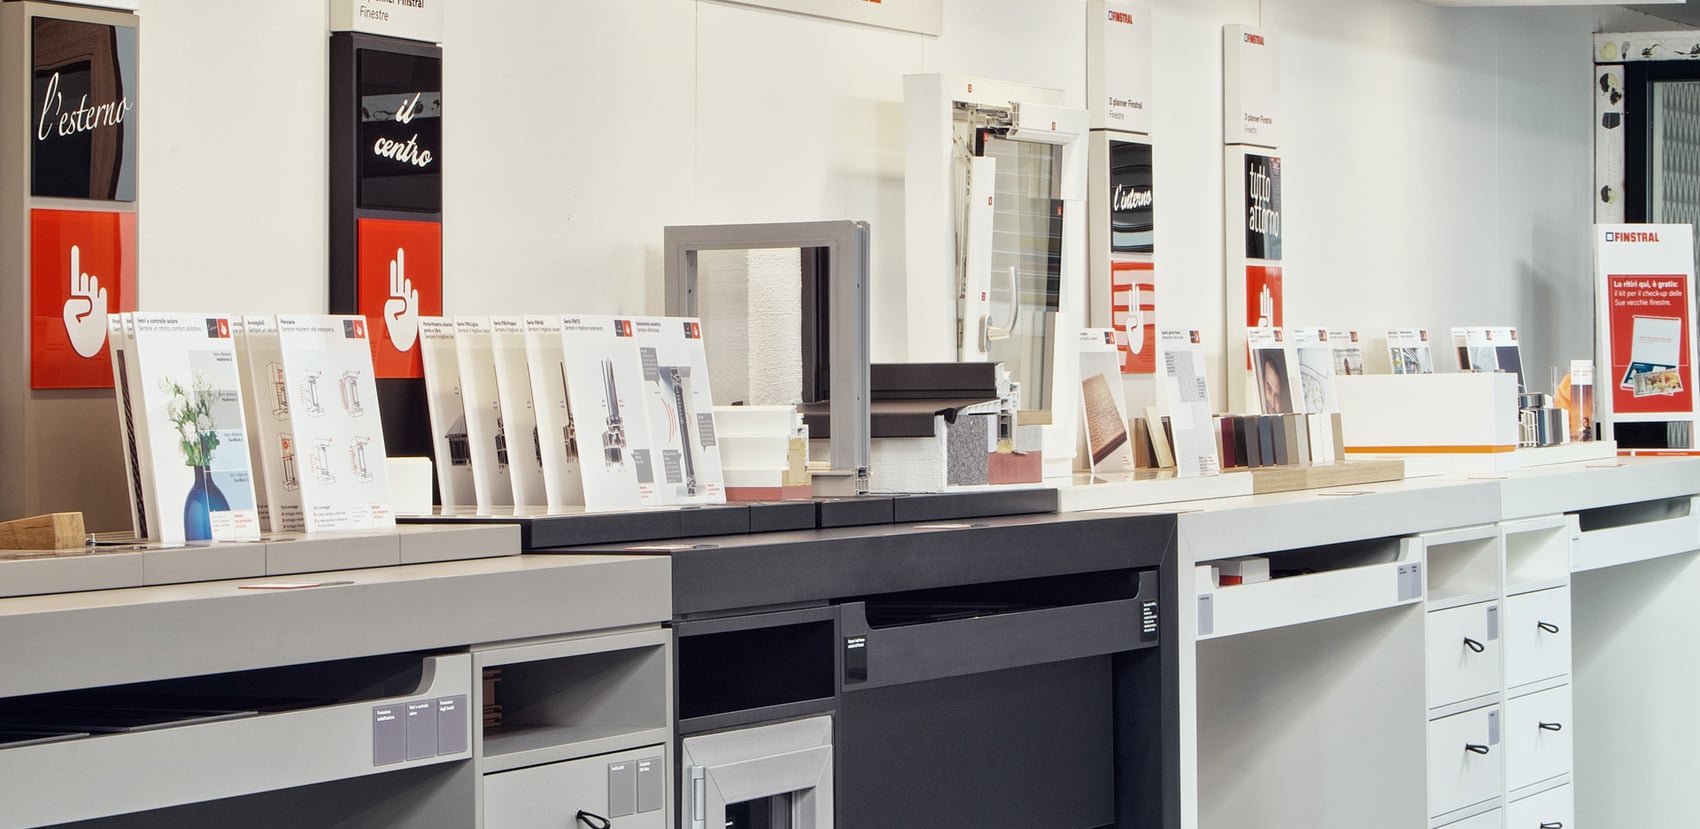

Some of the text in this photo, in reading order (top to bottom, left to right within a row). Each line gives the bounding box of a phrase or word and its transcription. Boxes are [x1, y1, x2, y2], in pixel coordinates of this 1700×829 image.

[360, 5, 389, 21] Finestre
[1112, 11, 1133, 24] FINSTRAL
[1247, 33, 1265, 46] FINSTRAL
[38, 72, 134, 141] l'esterno
[395, 92, 421, 124] il
[1113, 98, 1128, 108] planner
[1128, 99, 1143, 109] Finstral
[374, 133, 433, 168] centro
[1249, 162, 1271, 203] tutto
[1114, 183, 1152, 212] l'interno
[1249, 205, 1280, 237] attorno
[1614, 232, 1660, 242] FINSTRAL
[1613, 280, 1622, 288] Lo
[1623, 280, 1638, 288] ritiri
[1638, 280, 1651, 289] qui,
[1658, 280, 1679, 289] gratis:
[1642, 290, 1667, 298] check-up
